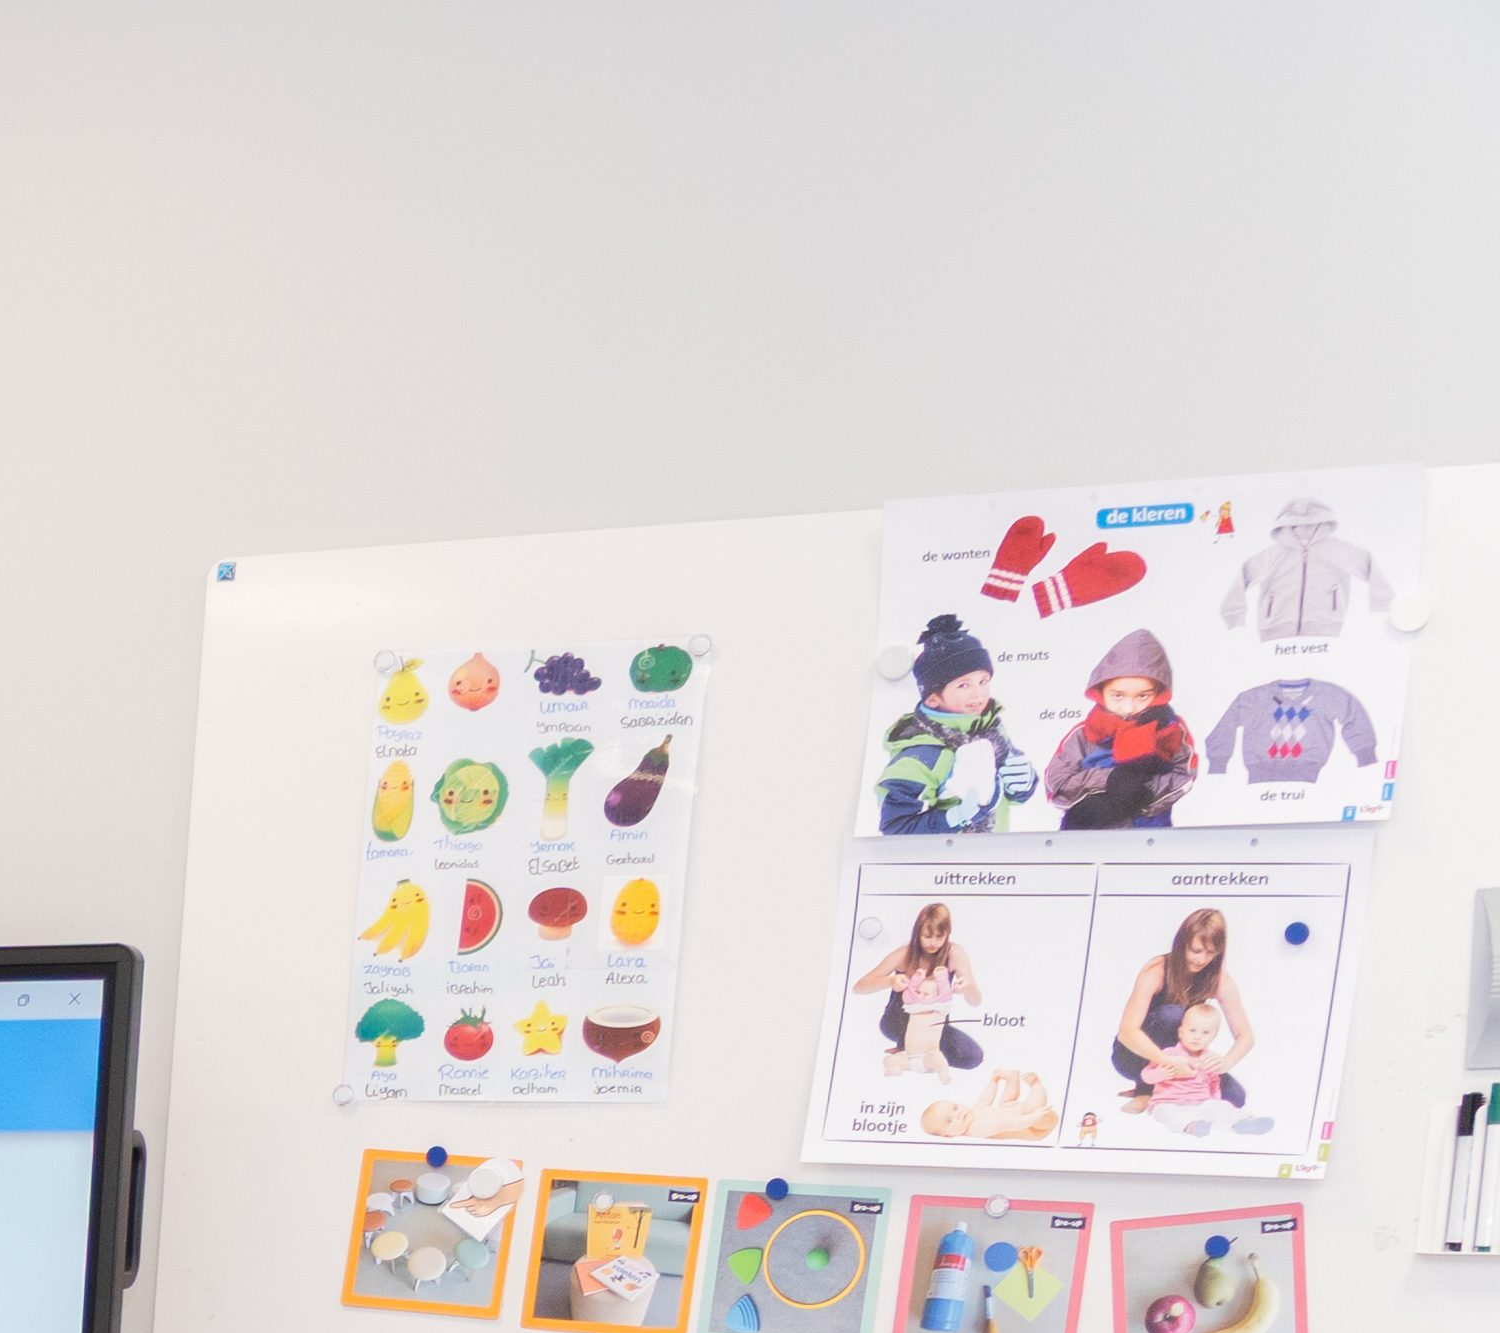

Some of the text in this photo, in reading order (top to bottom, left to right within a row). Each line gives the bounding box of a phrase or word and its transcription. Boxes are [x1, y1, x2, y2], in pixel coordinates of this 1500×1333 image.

[1105, 505, 1187, 525] de kleren
[922, 548, 991, 563] de wanten
[1274, 642, 1330, 656] het vest
[997, 650, 1050, 663] de muts
[1039, 708, 1082, 720] de das
[1260, 789, 1306, 802] de trui
[934, 872, 1017, 886] uittrekken
[1171, 872, 1269, 886] aantrekken
[983, 1013, 1026, 1027] bloot
[860, 1101, 905, 1117] in zijn
[852, 1118, 908, 1135] blootje
